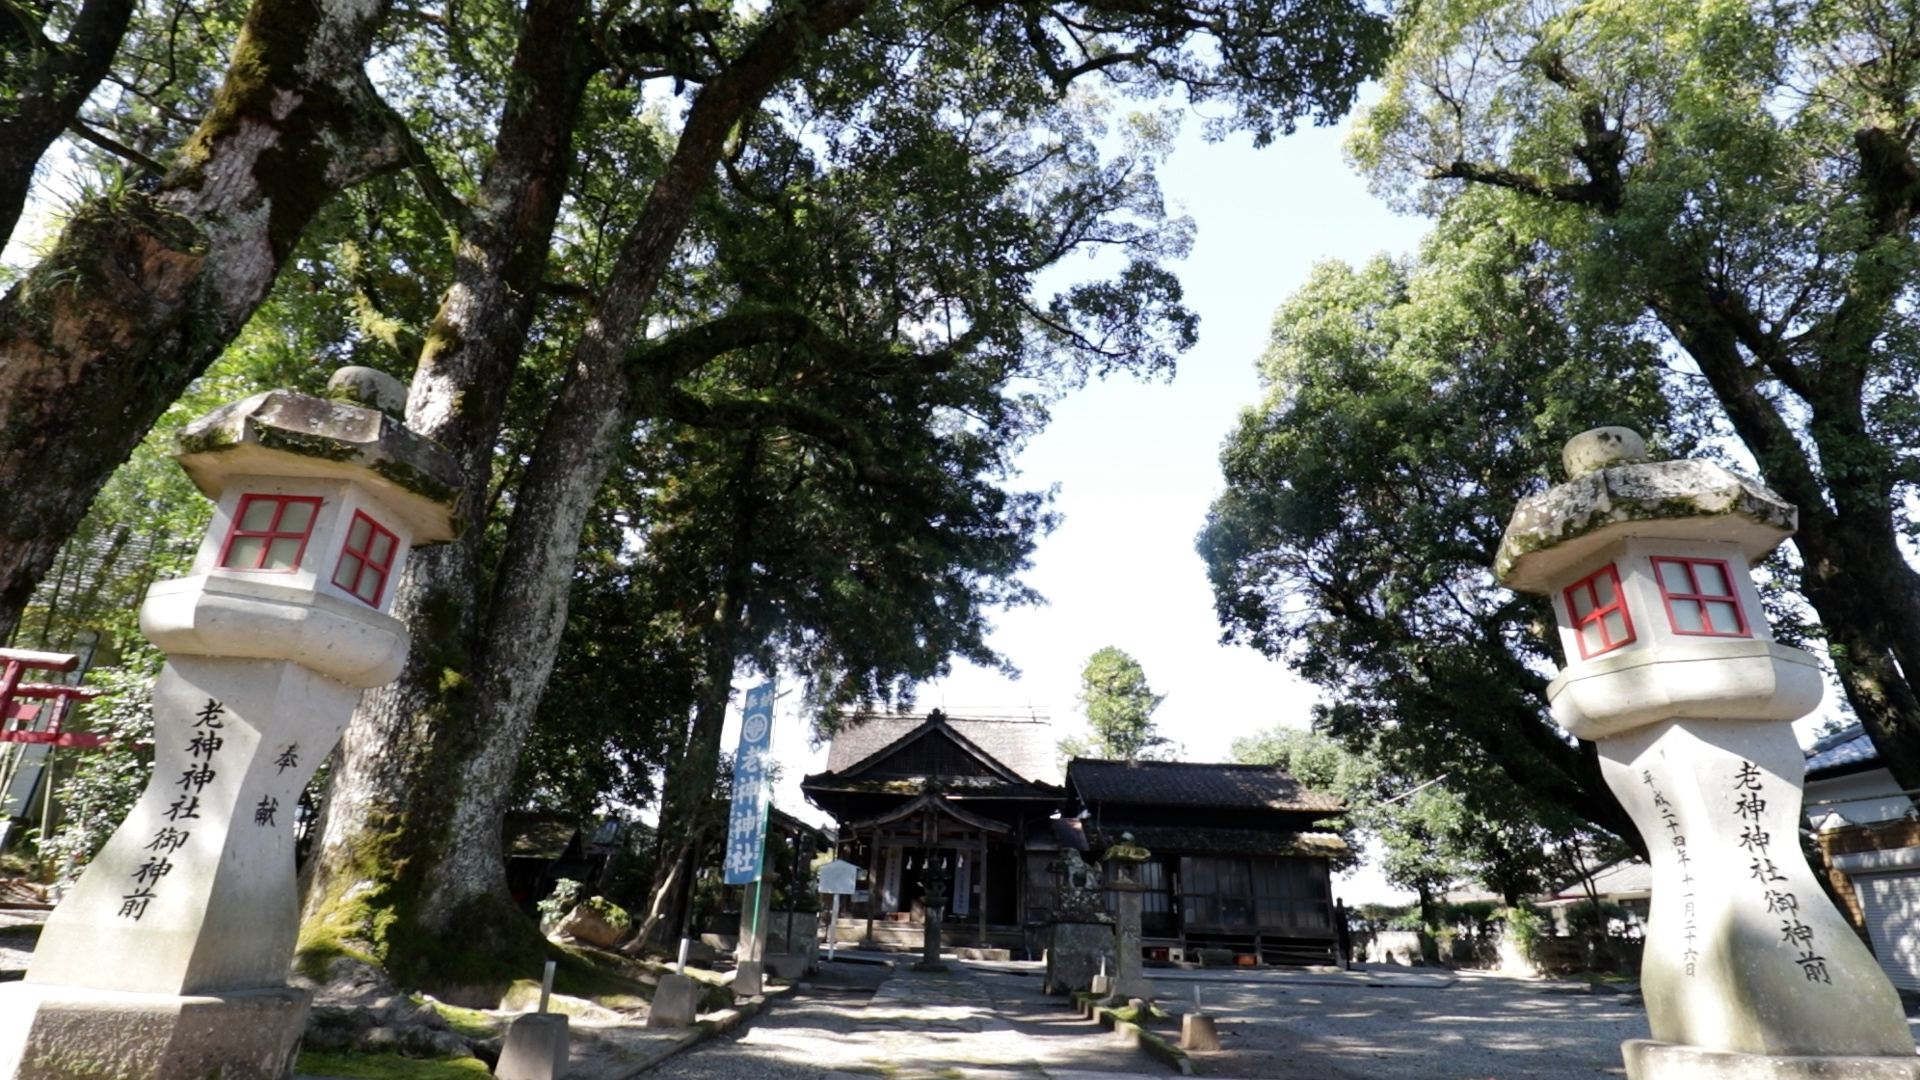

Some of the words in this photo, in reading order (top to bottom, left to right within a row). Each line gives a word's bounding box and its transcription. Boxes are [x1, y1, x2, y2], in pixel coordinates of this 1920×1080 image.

[117, 698, 226, 921] 老神神社御神前
[253, 741, 298, 828] 奉献
[732, 745, 763, 875] 老神神社
[1642, 769, 1699, 979] 平成二十四年十一月二十六日
[1732, 760, 1833, 985] 老神神社御神前
